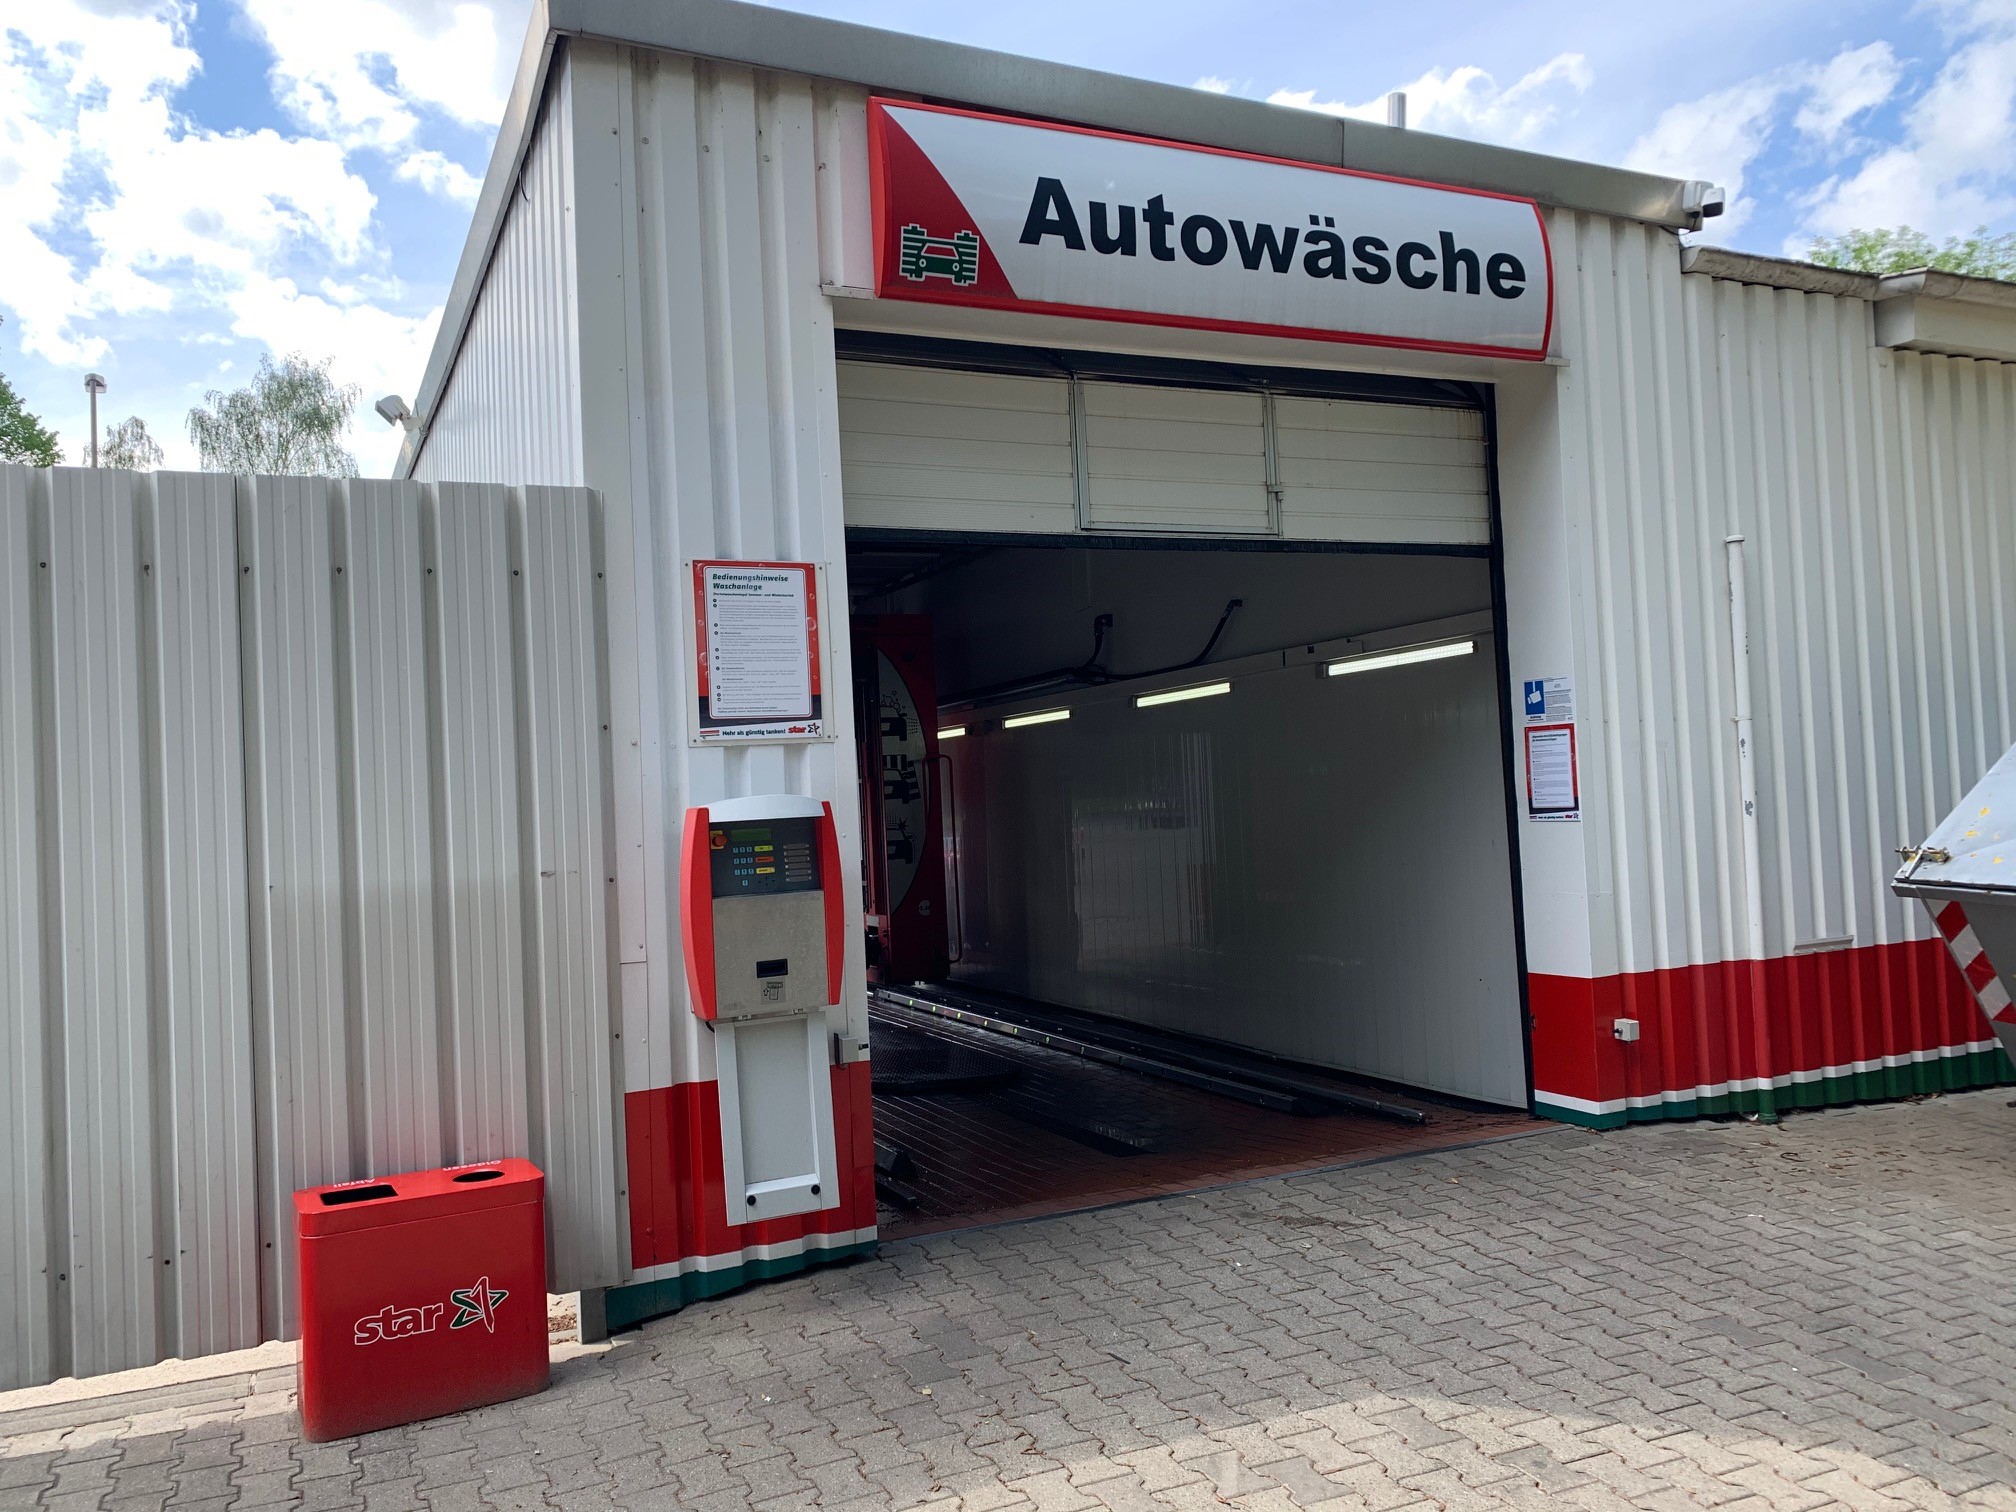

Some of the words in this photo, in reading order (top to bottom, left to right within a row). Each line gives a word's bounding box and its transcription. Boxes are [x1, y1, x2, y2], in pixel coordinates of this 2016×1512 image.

[1019, 176, 1526, 299] Autowäsche
[712, 573, 789, 583] Bedienungshinweise
[713, 583, 763, 591] Waschanlage
[788, 725, 807, 734] star
[354, 1303, 443, 1346] star
